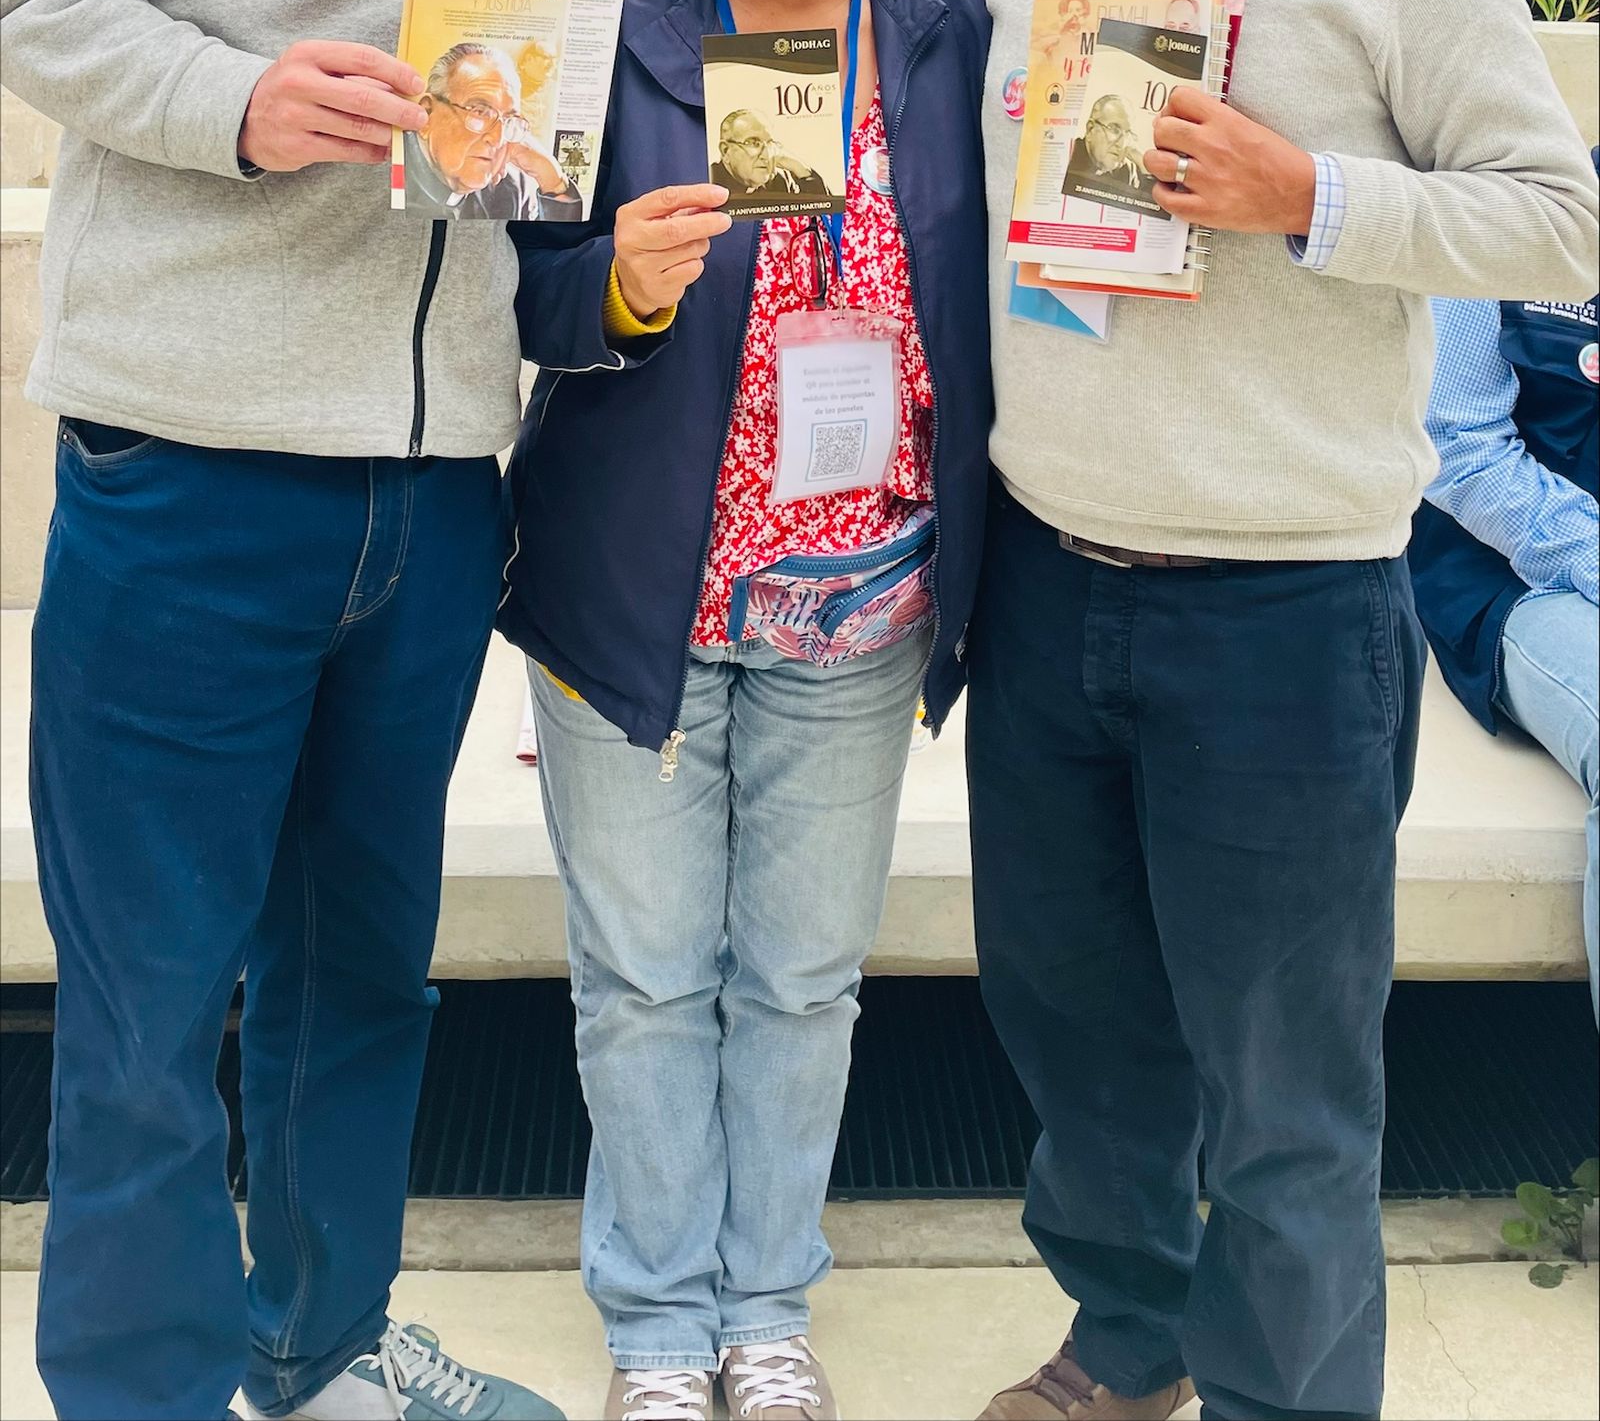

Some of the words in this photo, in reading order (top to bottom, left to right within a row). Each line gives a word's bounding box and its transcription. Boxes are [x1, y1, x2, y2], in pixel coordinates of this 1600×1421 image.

[772, 83, 824, 116] 100
[1138, 80, 1178, 113] 10
[736, 206, 780, 216] ANIVERSARIO
[800, 202, 831, 210] MARTIRIO
